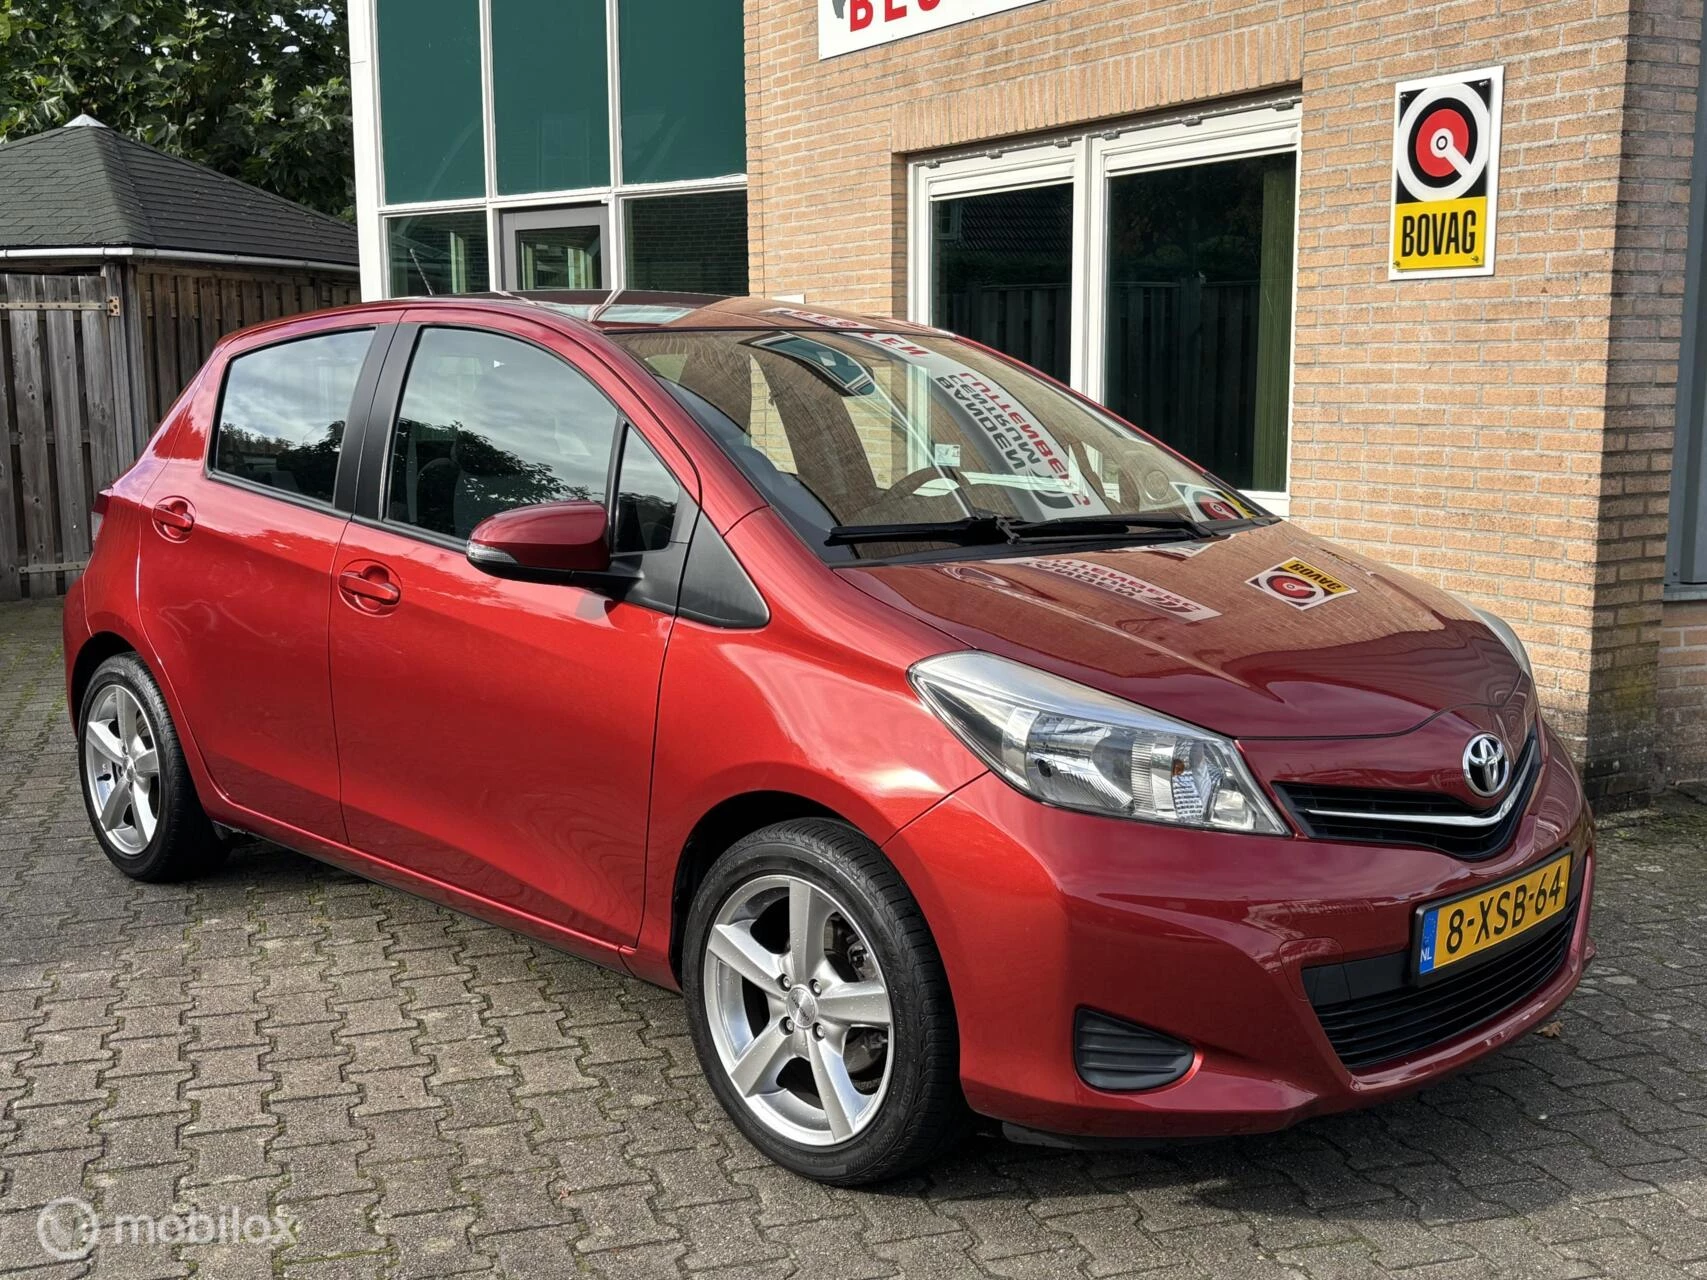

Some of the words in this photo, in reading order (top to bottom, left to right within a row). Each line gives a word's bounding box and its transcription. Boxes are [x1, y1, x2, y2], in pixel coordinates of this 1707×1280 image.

[1401, 209, 1477, 258] BOVAG
[1446, 866, 1562, 954] 8-XSB-64
[1420, 948, 1433, 962] NL
